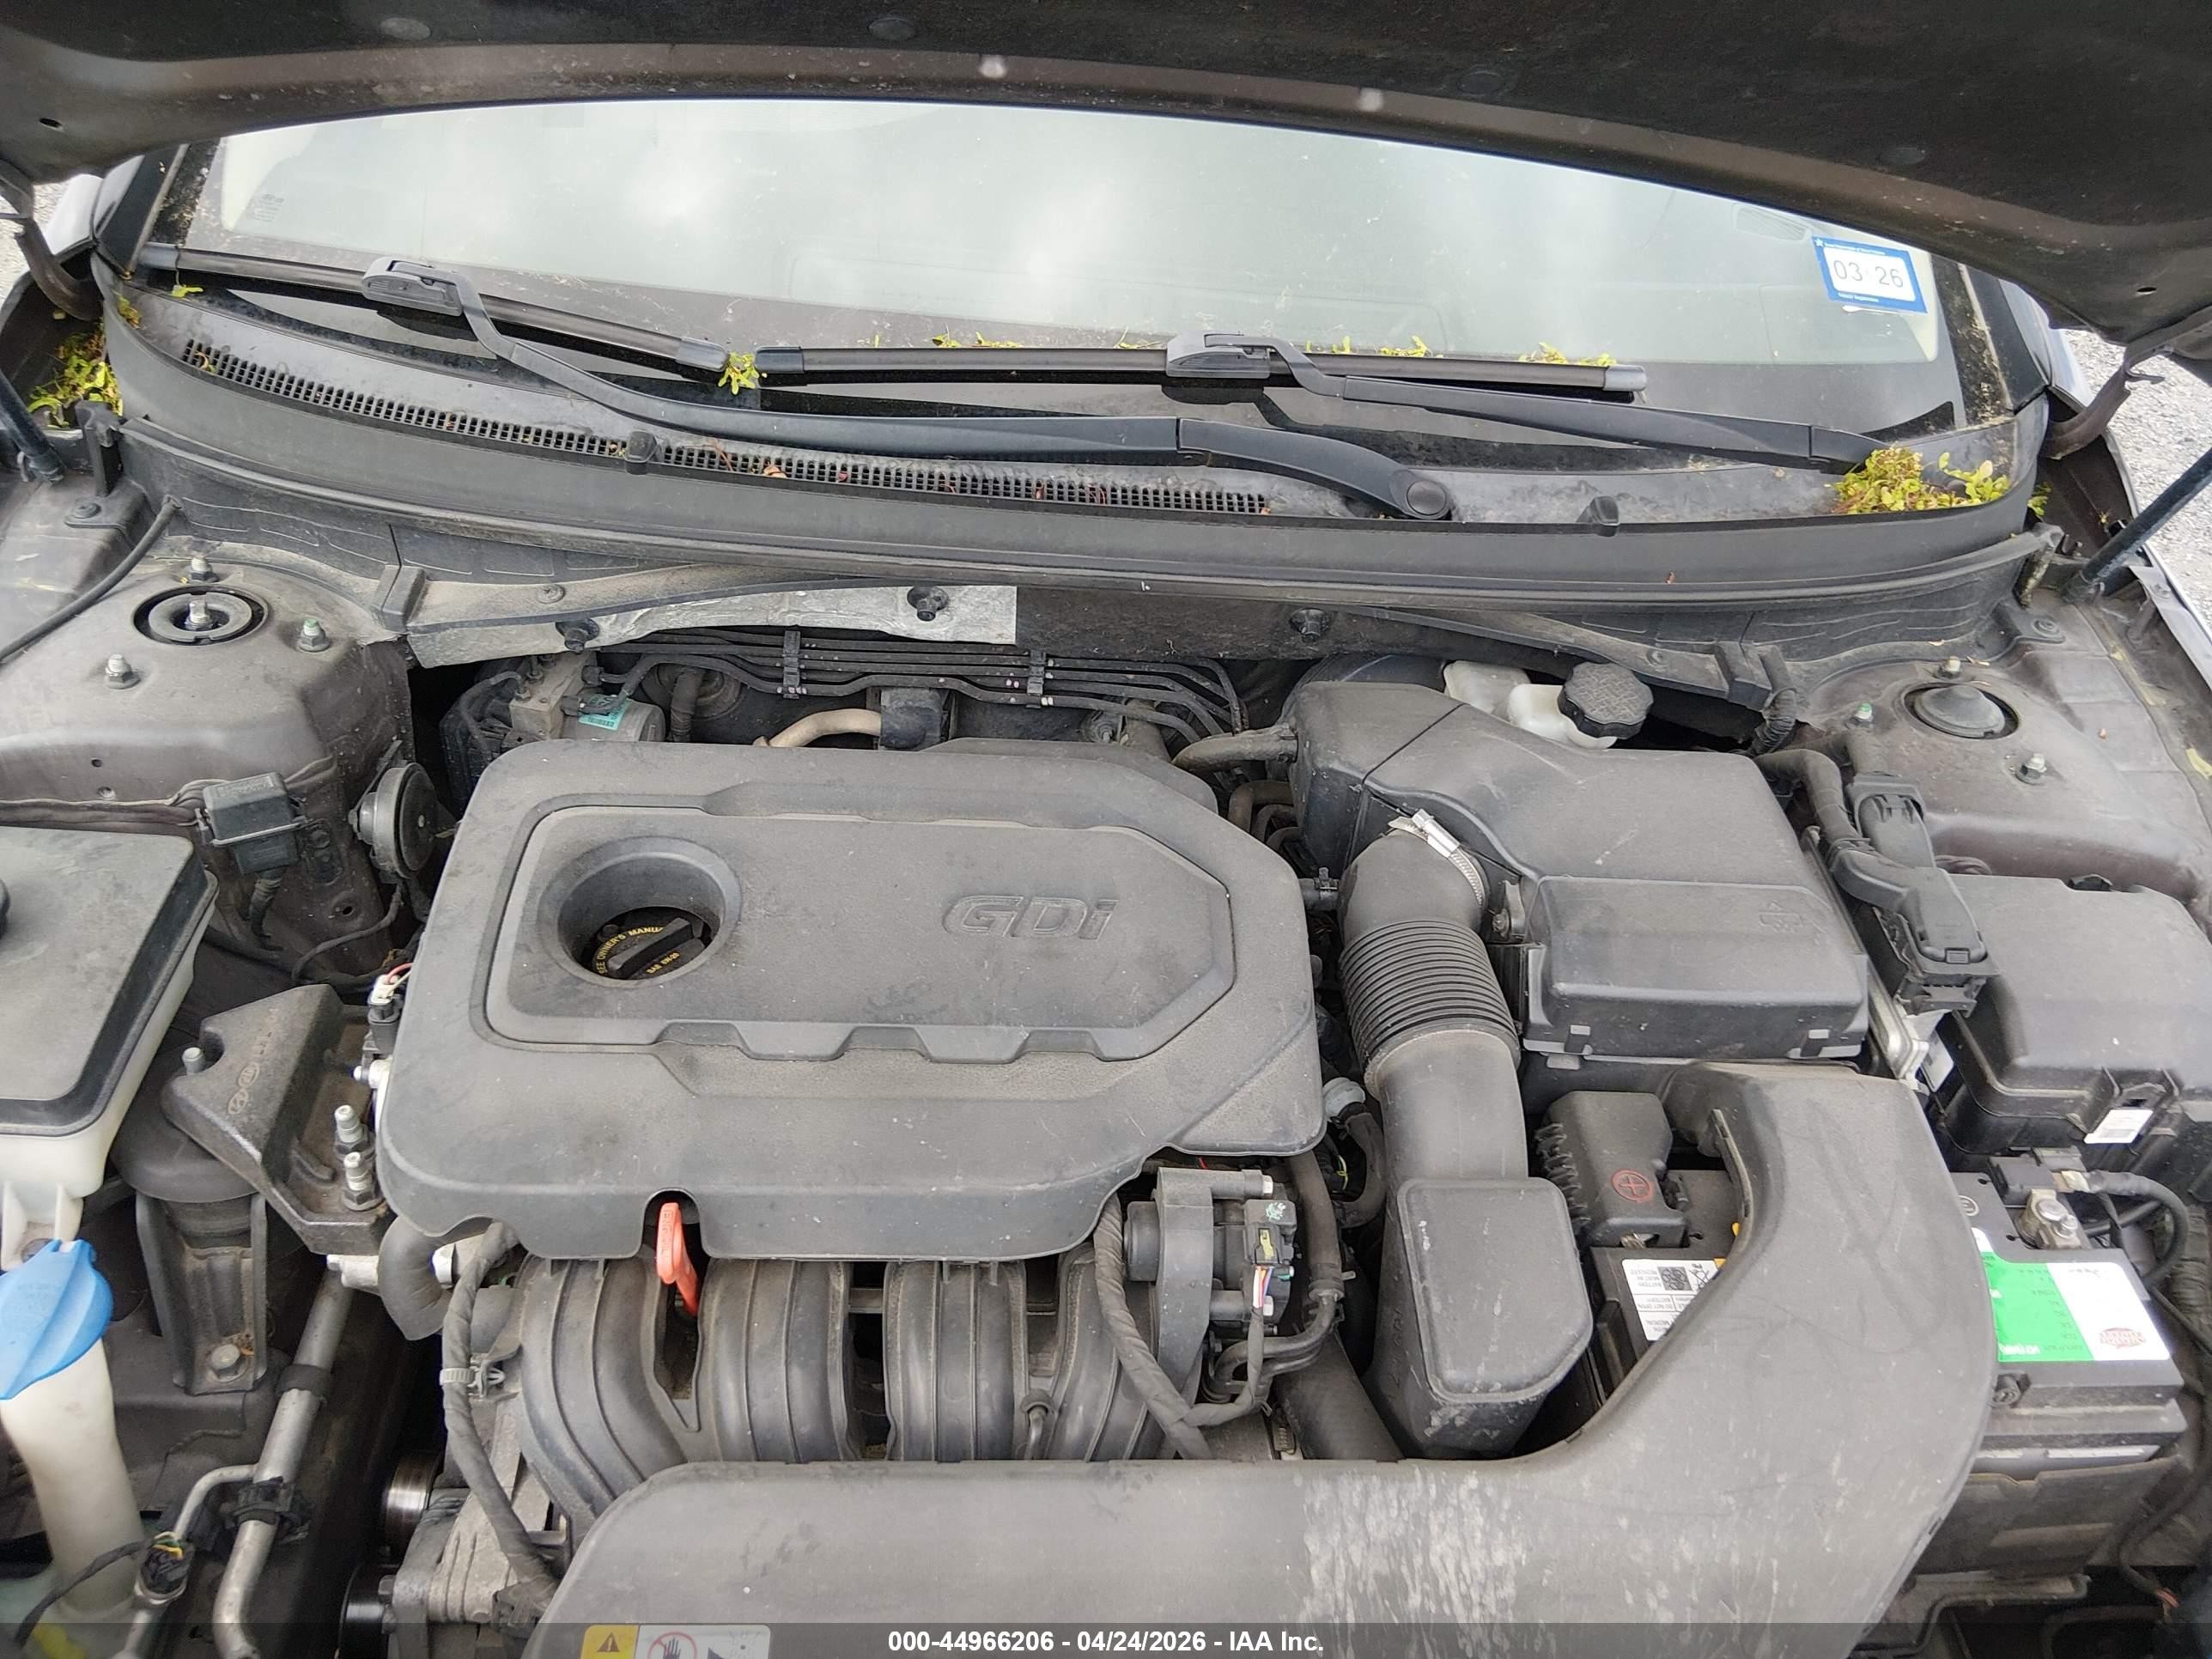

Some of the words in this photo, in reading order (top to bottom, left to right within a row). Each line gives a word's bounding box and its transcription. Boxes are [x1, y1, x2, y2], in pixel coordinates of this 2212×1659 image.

[1833, 259, 1863, 282] 03
[1875, 265, 1904, 288] 26
[597, 933, 626, 960] OWNER'S
[596, 962, 607, 974] SEE
